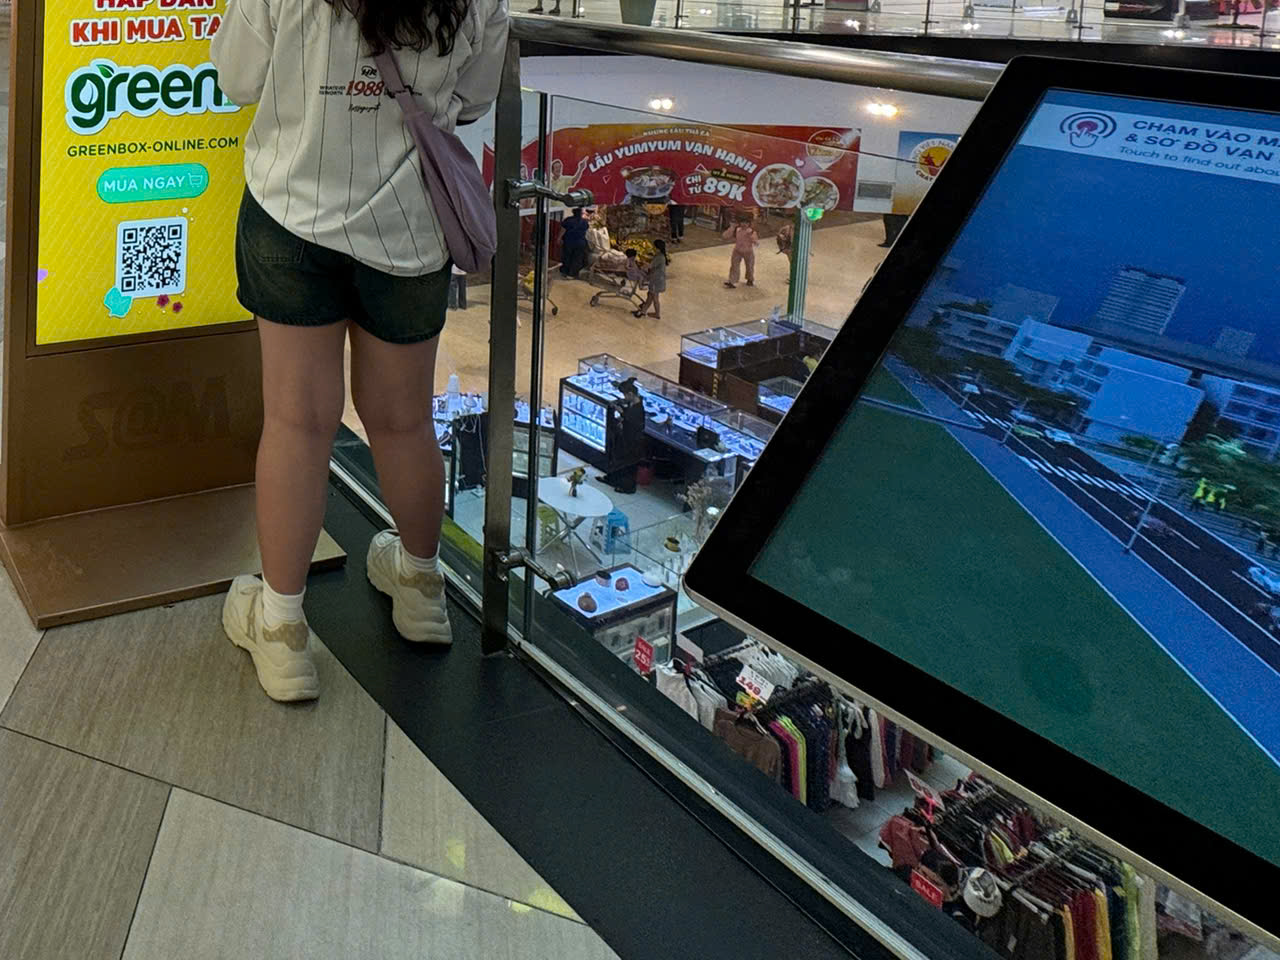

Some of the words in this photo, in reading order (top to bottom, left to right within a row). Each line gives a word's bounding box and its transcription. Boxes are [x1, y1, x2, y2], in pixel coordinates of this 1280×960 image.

[73, 21, 118, 42] KHI
[127, 19, 182, 40] MUA
[191, 16, 221, 36] TA
[71, 64, 223, 128] green
[346, 81, 385, 96] 1988
[1133, 121, 1198, 136] CHẠM
[1205, 129, 1251, 143] VÀO
[1257, 136, 1280, 148] M
[67, 137, 239, 157] GREENBOX-ONLINE.COM
[615, 140, 681, 159] YUMYUM
[685, 141, 713, 156] VẠN
[715, 148, 757, 174] HẠNH
[1120, 146, 1160, 158] Touch
[1164, 153, 1178, 161] to
[1183, 155, 1212, 166] find
[1215, 162, 1241, 170] out
[1125, 133, 1138, 143] &
[1184, 140, 1218, 153] ĐỒ
[1226, 146, 1274, 161] VẠN
[104, 179, 138, 192] MUA
[144, 175, 185, 190] NGAY
[703, 178, 746, 201] 89K
[915, 880, 937, 900] SALE
